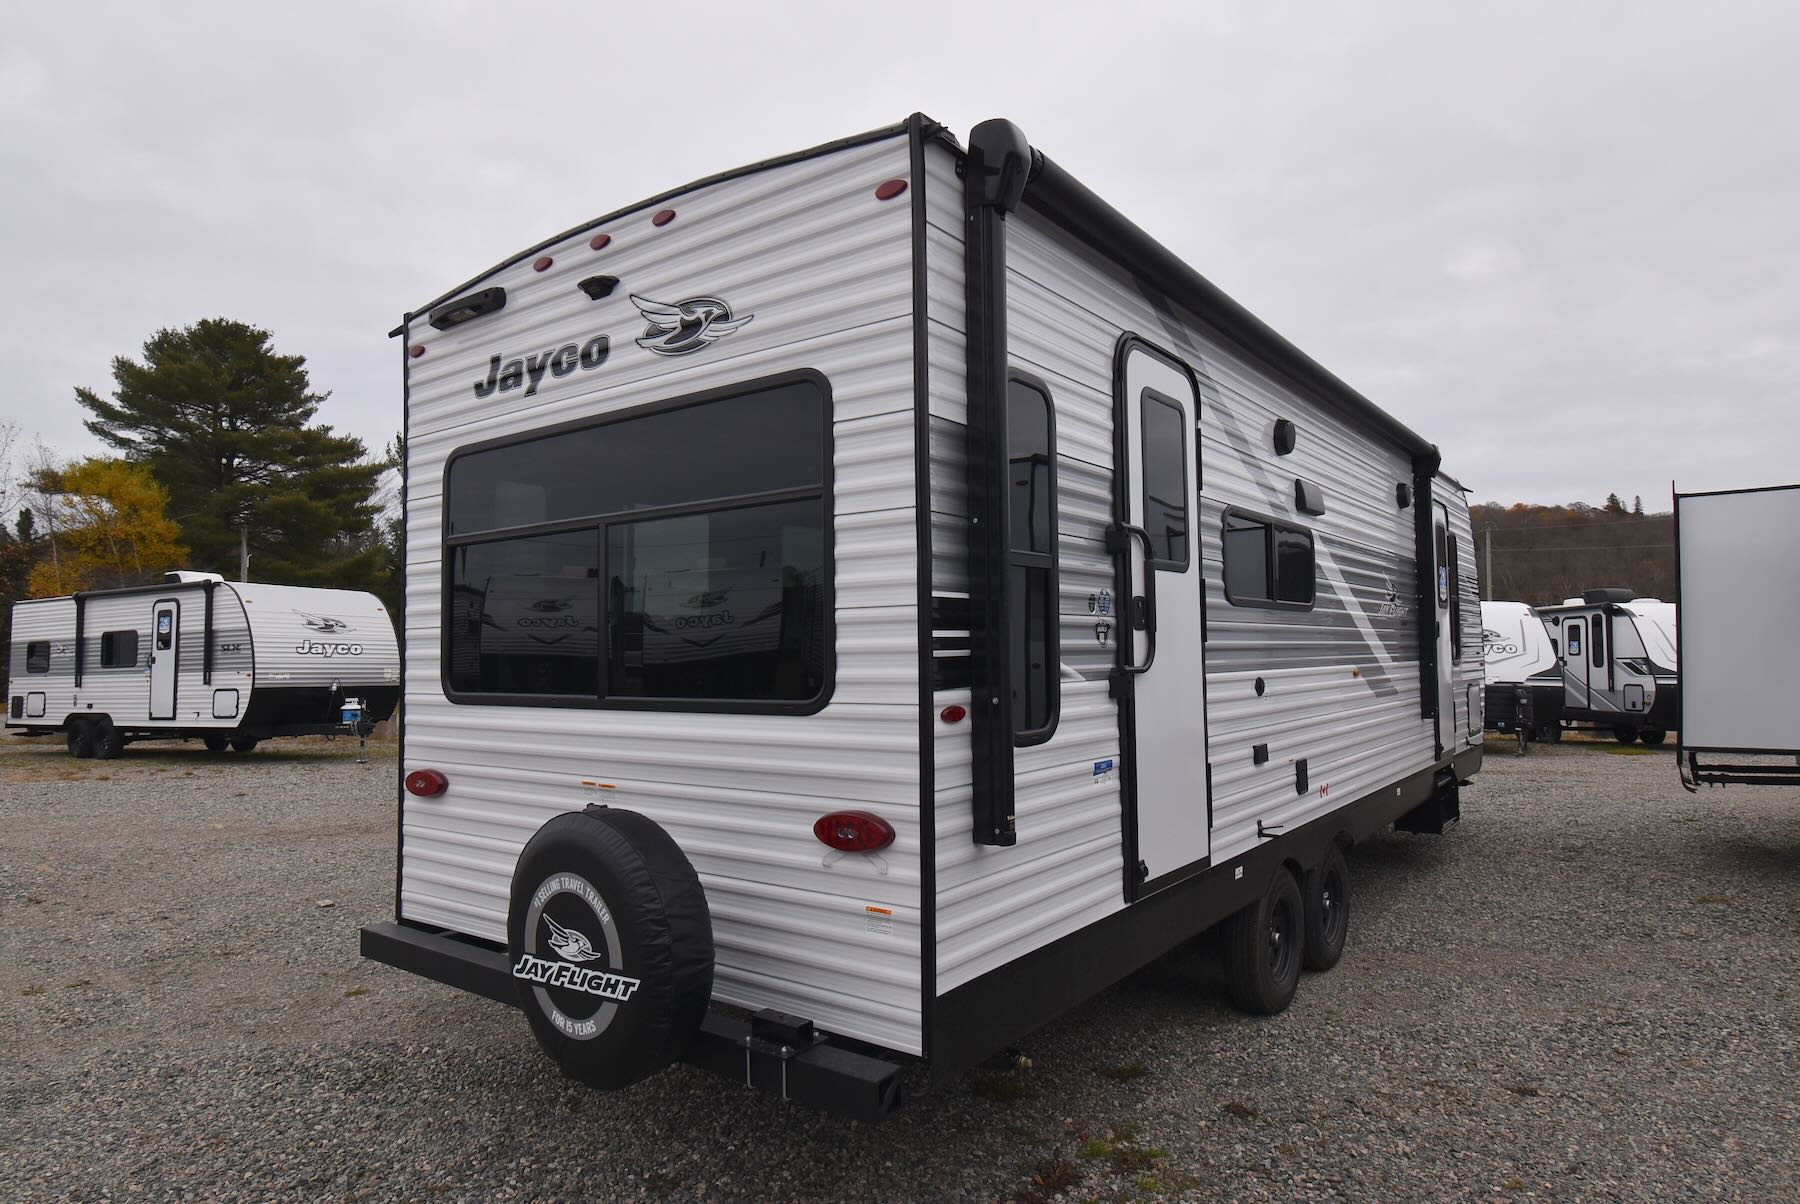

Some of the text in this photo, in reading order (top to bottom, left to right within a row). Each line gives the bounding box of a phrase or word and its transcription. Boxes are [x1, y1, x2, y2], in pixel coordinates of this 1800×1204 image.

[474, 333, 610, 399] Jayco
[296, 640, 363, 658] Jayco
[538, 878, 560, 903] SELLING
[560, 877, 584, 894] TRAVEL
[585, 887, 610, 925] TRAILER
[551, 1010, 597, 1036] FOR 15 YEARS
